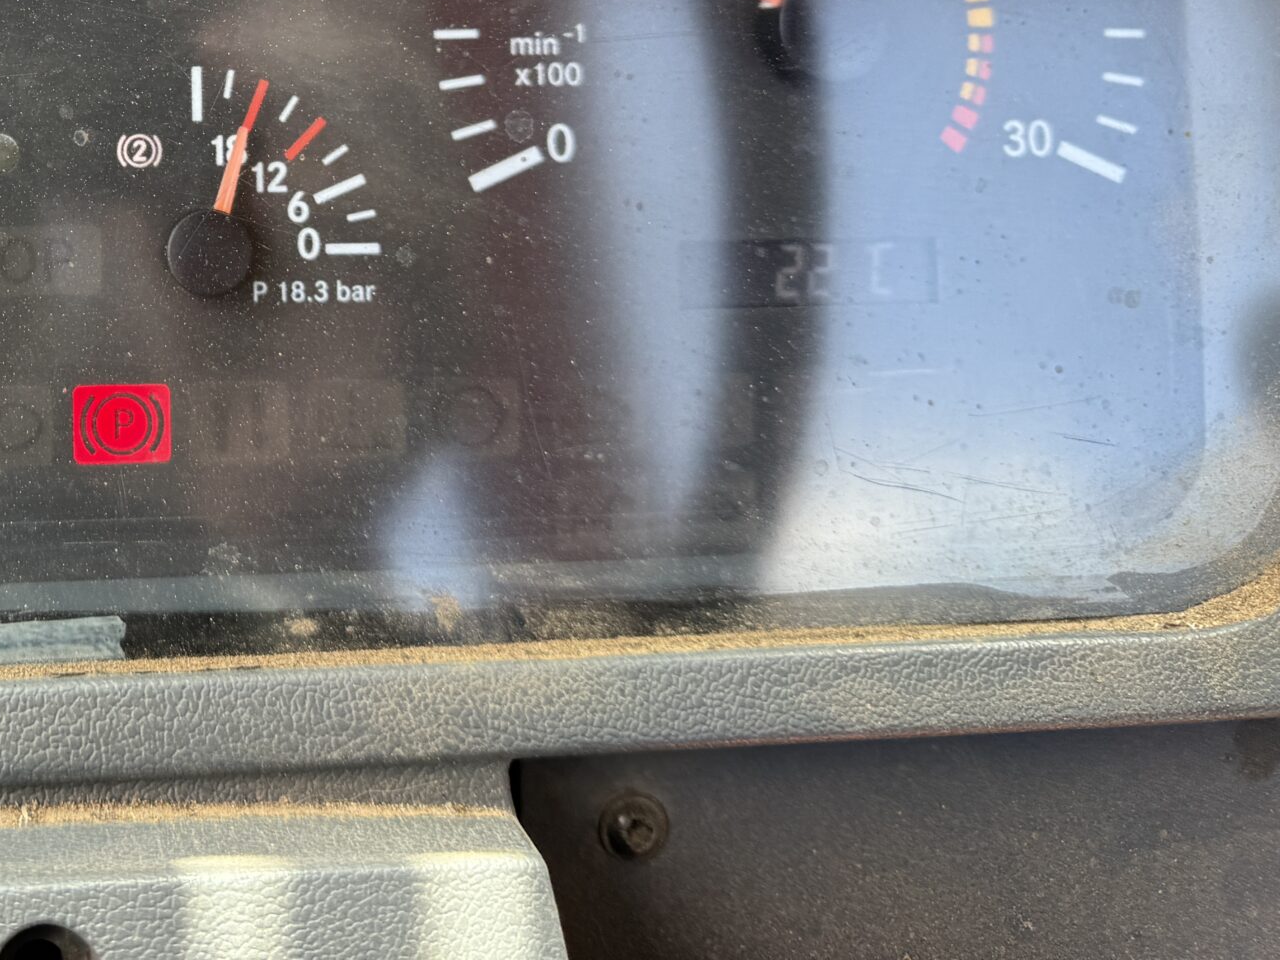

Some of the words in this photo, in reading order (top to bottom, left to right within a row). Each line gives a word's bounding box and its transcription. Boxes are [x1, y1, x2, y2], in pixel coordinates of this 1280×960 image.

[514, 62, 582, 87] x100
[546, 123, 575, 162] 0
[1002, 120, 1052, 158] 30
[251, 161, 289, 194] 12
[287, 190, 310, 224] 6
[296, 227, 320, 261] 0
[251, 281, 268, 303] P
[279, 280, 329, 303] 18.3
[336, 280, 376, 303] bar
